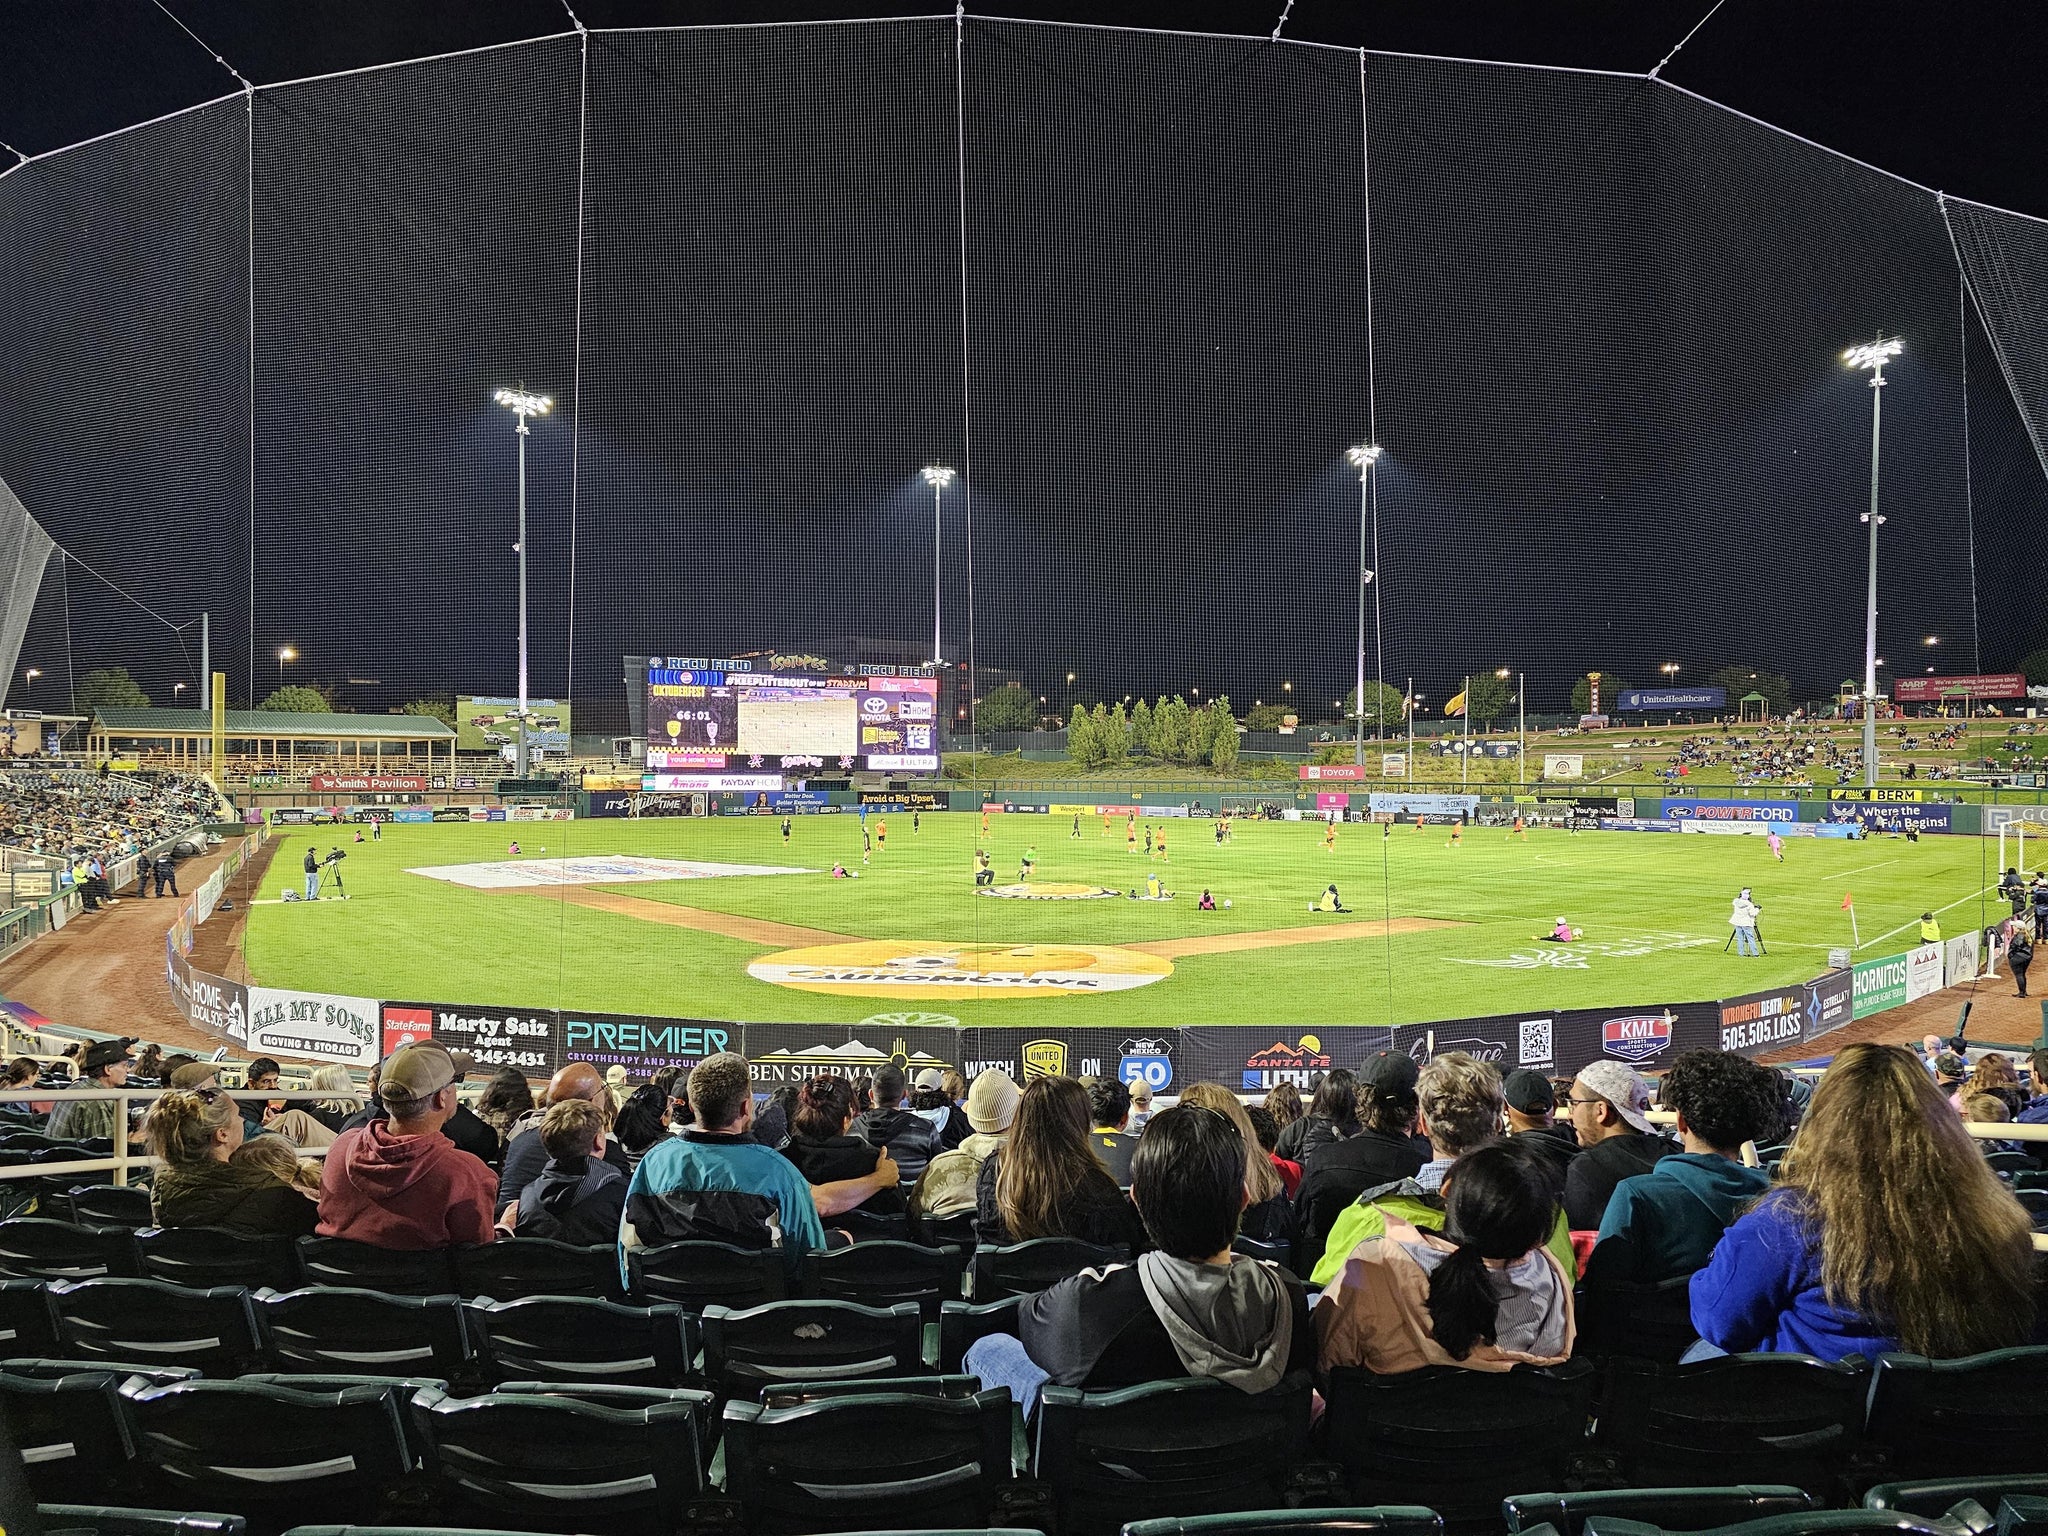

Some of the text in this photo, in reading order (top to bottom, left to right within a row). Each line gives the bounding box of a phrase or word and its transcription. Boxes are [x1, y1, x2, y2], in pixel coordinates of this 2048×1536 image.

[667, 657, 751, 671] RGCU FIELD
[860, 664, 935, 678] RGCU FIELD
[653, 685, 705, 697] OKTOBERFEST
[1643, 695, 1711, 703] UnitedHealthcare
[676, 711, 711, 720] 66:01
[912, 706, 930, 715] HOME
[907, 736, 930, 748] 13
[335, 778, 417, 788] Smith's Pavilion
[668, 777, 709, 788] Amana
[862, 795, 887, 803] Avoid
[895, 795, 910, 804] Big
[911, 795, 935, 803] Upset.
[1877, 791, 1914, 800] BERM
[605, 801, 624, 809] IT'S
[659, 800, 680, 809] TIME
[1863, 806, 1920, 816] Where the
[1905, 817, 1947, 829] Begins!
[808, 973, 1098, 987] AUTOMOTIVE
[1854, 961, 1905, 997] HORNITOS
[193, 980, 221, 1009] HOME
[192, 1003, 222, 1027] LOCAL 505
[252, 1000, 374, 1045] ALL MY SONS
[439, 1013, 548, 1036] Marty Saiz
[1621, 1020, 1655, 1039] KMI
[1722, 1012, 1800, 1051] 505.505.LOSS
[474, 1034, 512, 1047] Agent
[567, 1021, 729, 1055] PREMIER
[263, 1035, 358, 1056] MOVING & STORAGE
[567, 1053, 639, 1065] CRYOTHERAPY
[644, 1057, 665, 1066] AND
[1031, 1052, 1058, 1061] UNITED
[1247, 1059, 1330, 1067] SANTA FE
[750, 1066, 874, 1082] BEN SHERMA
[1081, 1058, 1100, 1077] ON
[1126, 1062, 1166, 1086] 50
